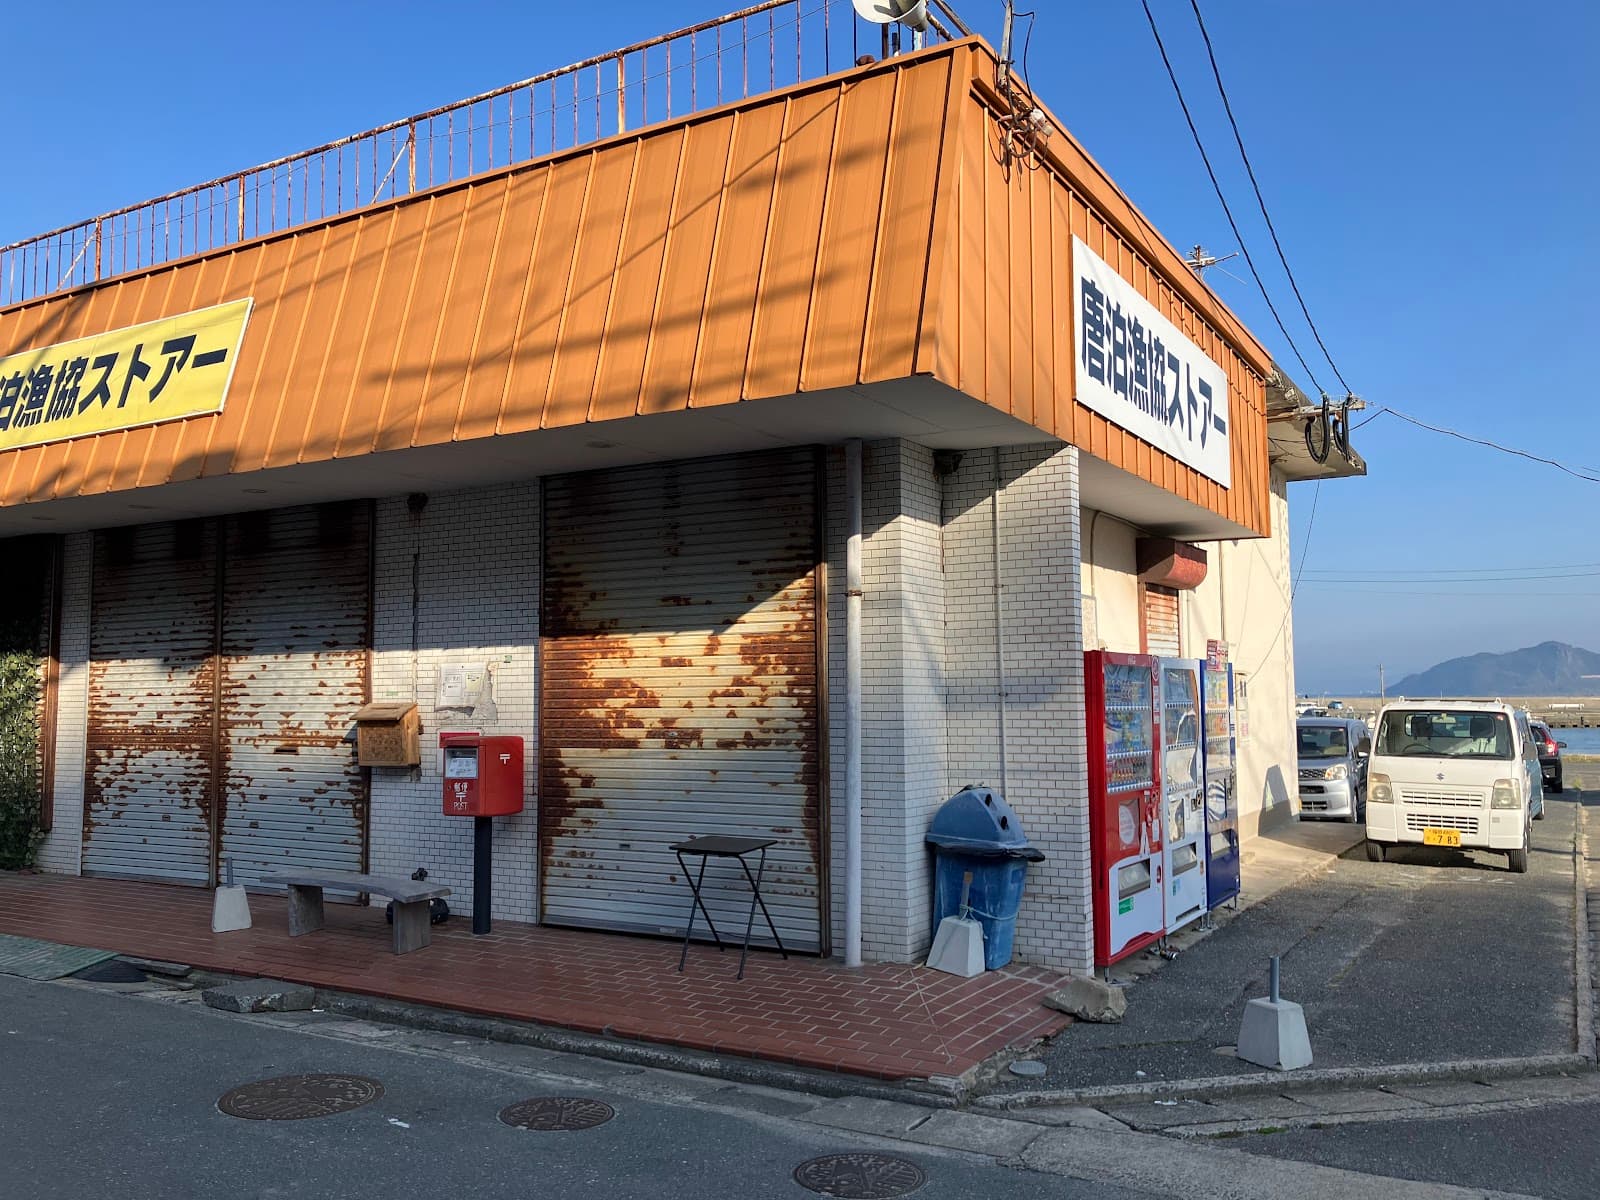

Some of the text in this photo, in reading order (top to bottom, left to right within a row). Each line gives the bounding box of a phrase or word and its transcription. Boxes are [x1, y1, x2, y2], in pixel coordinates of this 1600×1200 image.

[1081, 276, 1226, 449] 唐泊漁協ストアー
[454, 782, 468, 792] 郵便
[454, 801, 468, 811] POST
